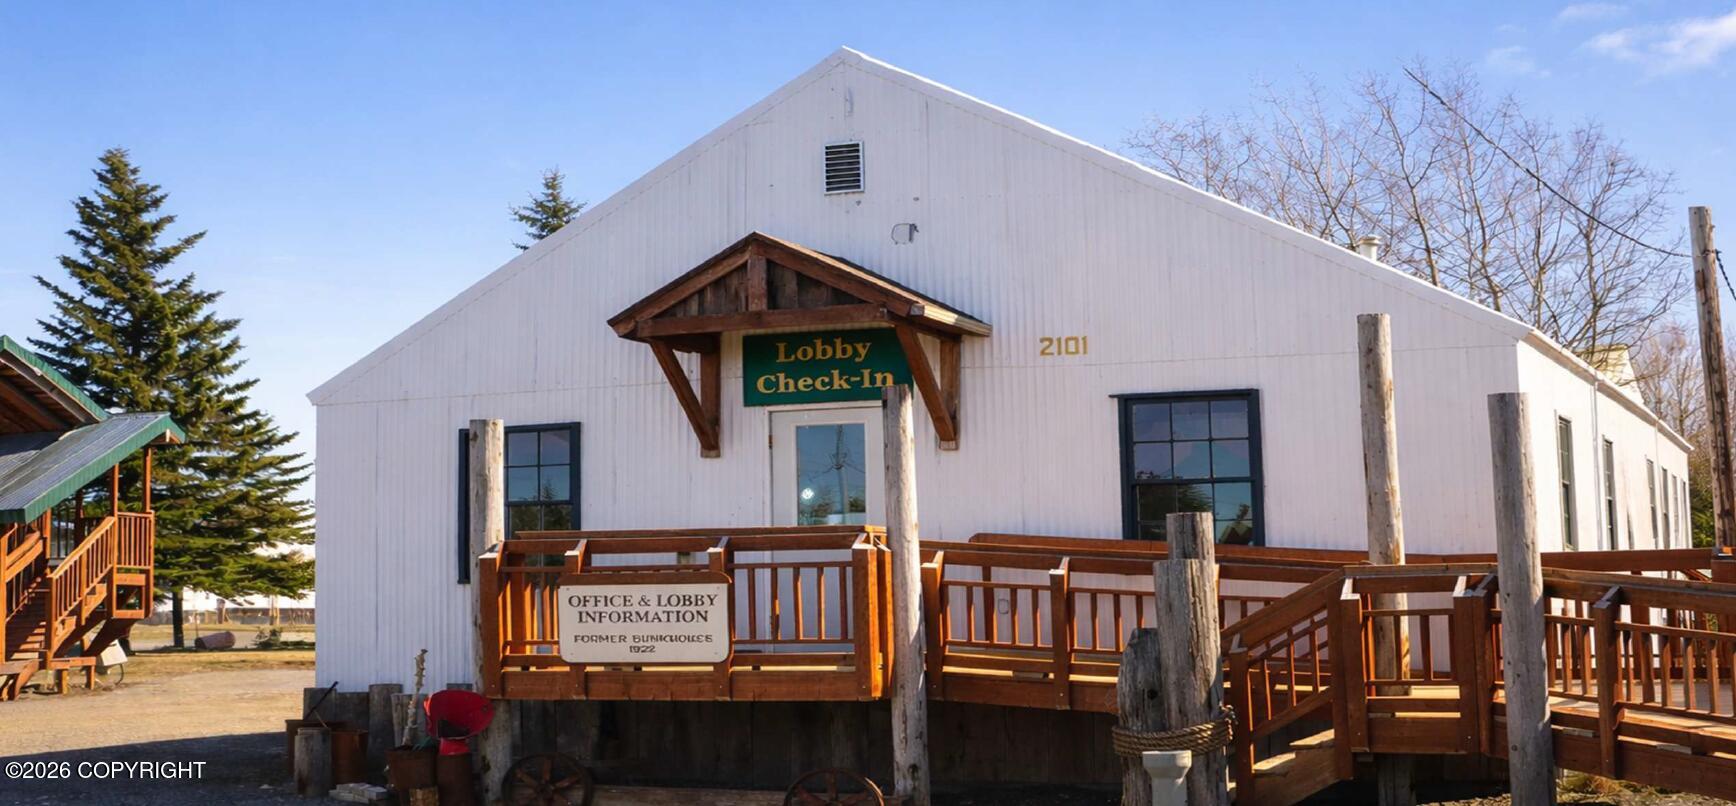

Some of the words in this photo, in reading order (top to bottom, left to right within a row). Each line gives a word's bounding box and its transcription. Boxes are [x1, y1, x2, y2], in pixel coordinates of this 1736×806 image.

[776, 338, 872, 363] Lobby
[1040, 336, 1089, 356] 2101
[756, 368, 894, 393] Check-In
[568, 595, 633, 608] OFFICE
[638, 595, 650, 607] &
[657, 593, 718, 607] LOBBY
[577, 610, 708, 623] INFORMATION
[574, 634, 627, 643] FORMER
[628, 645, 656, 653] 1922
